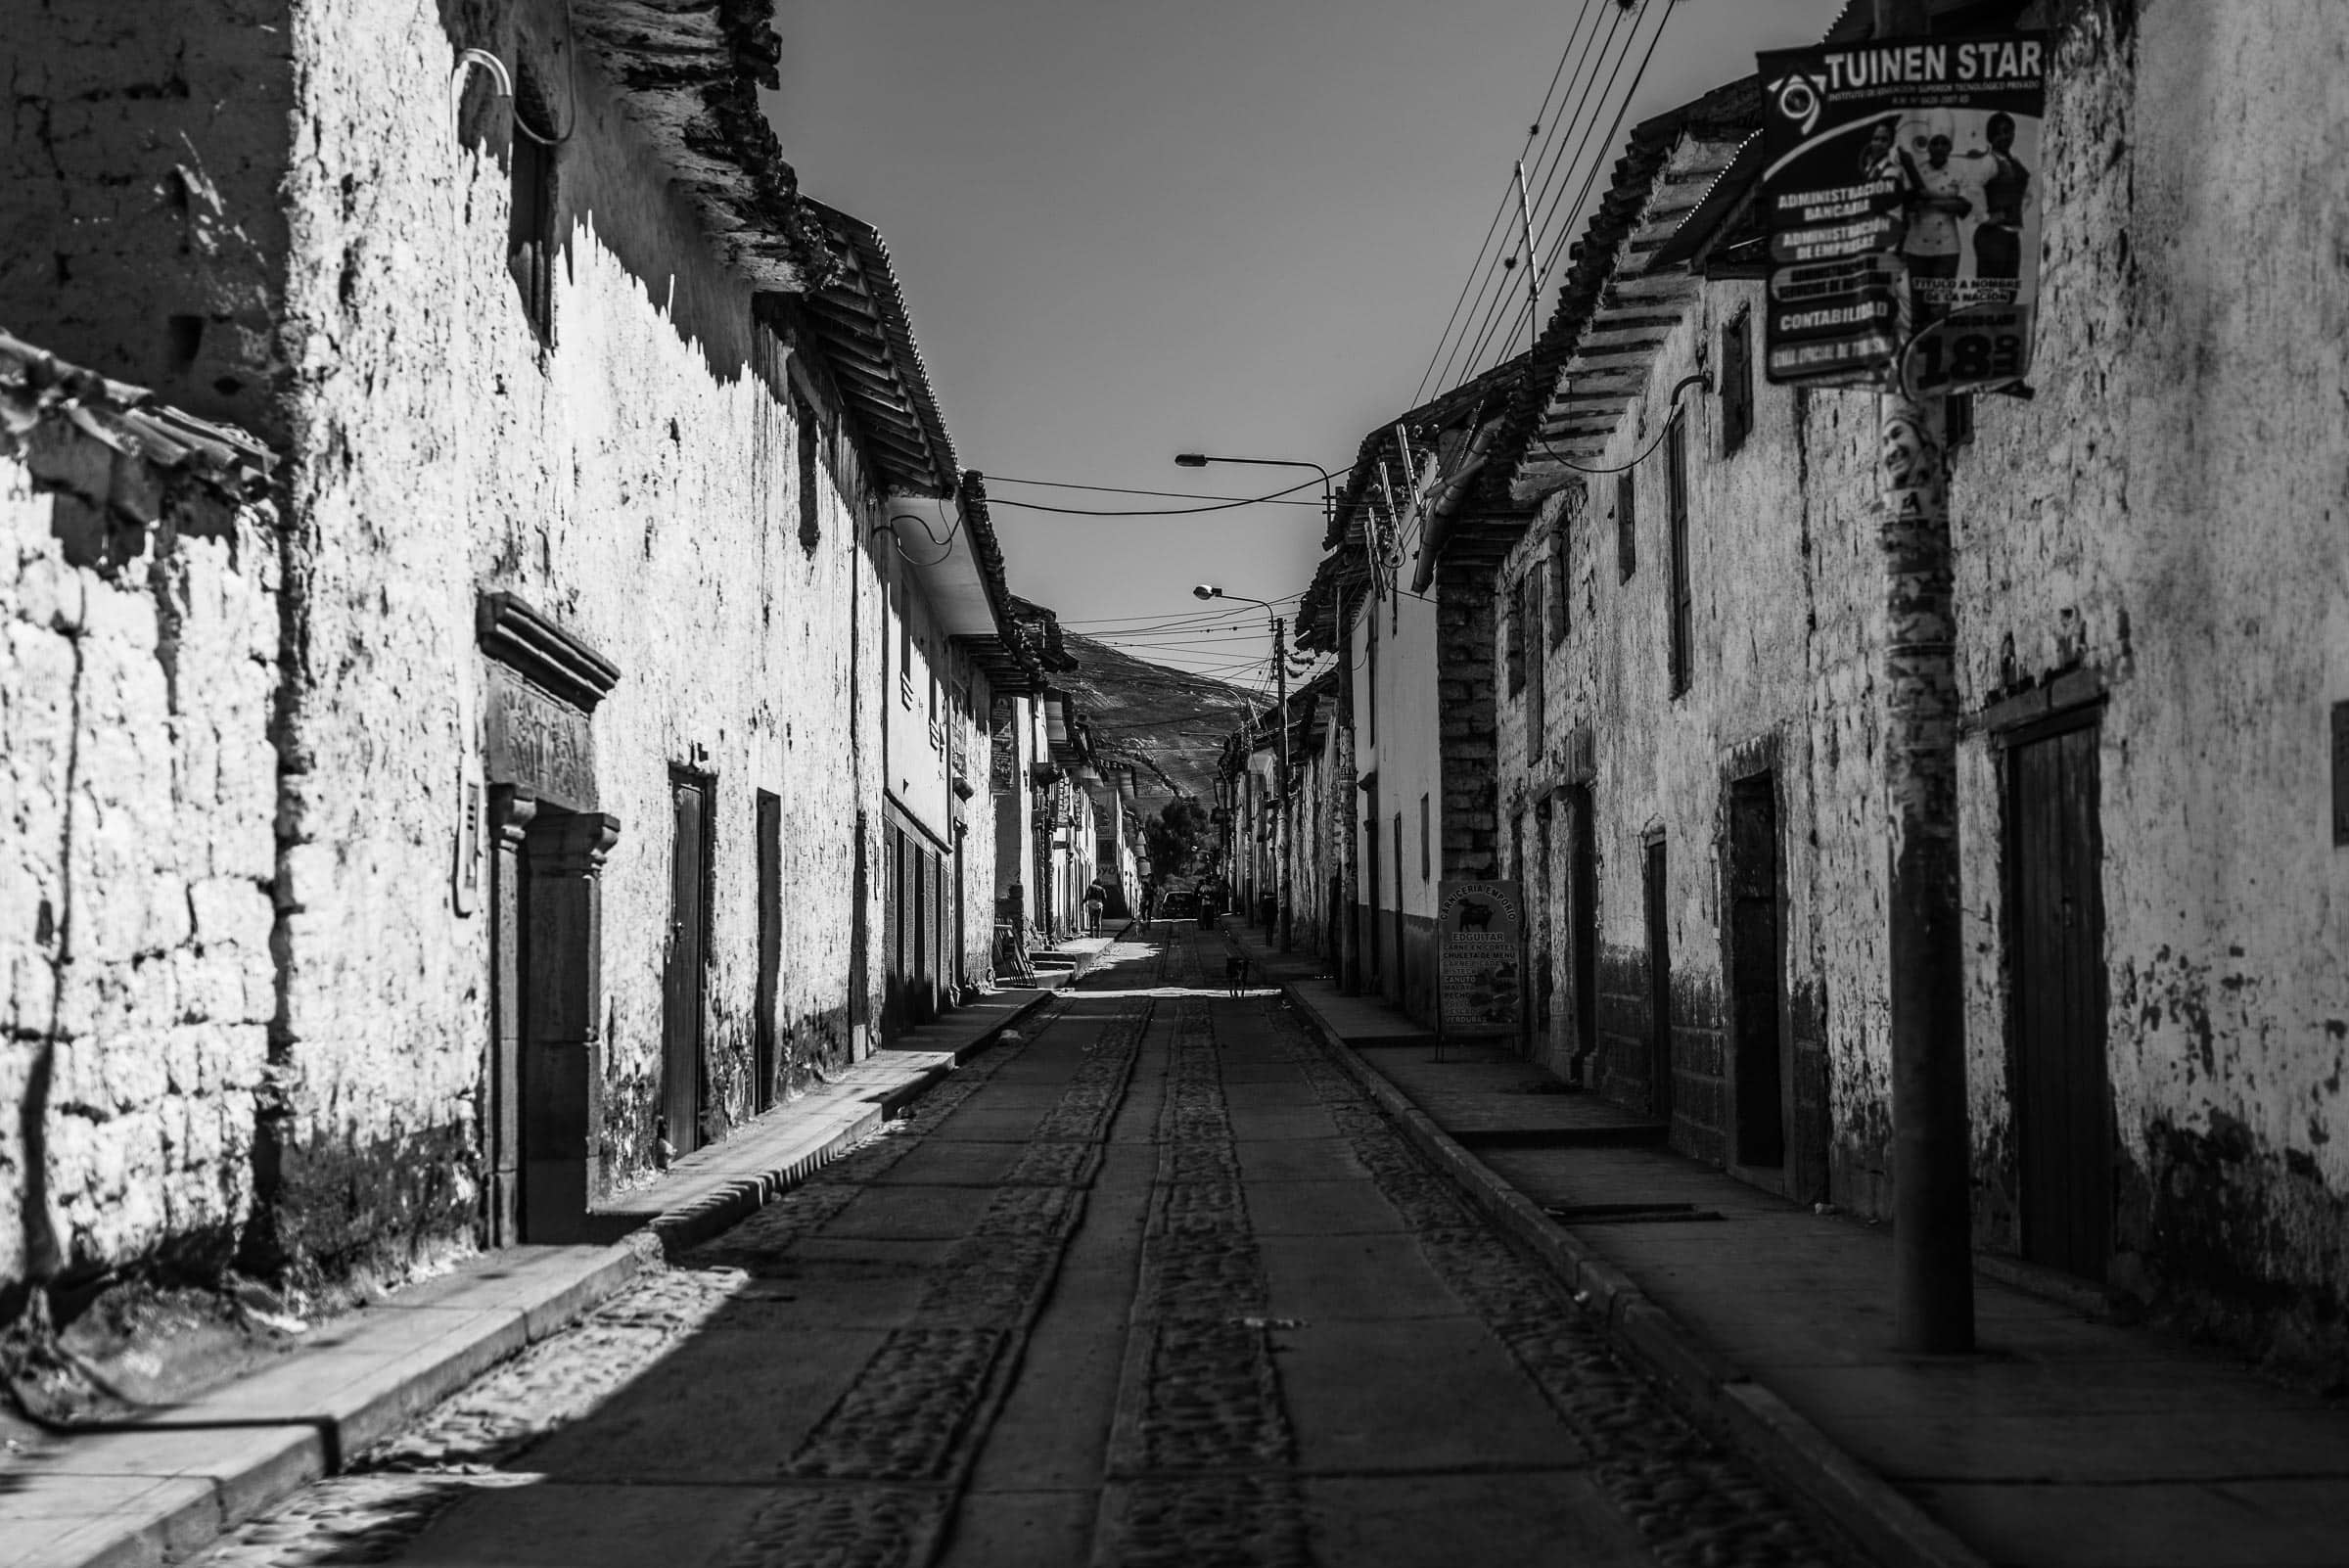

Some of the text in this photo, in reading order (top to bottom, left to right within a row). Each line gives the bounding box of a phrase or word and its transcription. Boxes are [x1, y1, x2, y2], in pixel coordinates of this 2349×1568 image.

[1824, 40, 2042, 89] TUINEN STAR
[1959, 279, 1968, 289] A
[1440, 884, 1516, 920] CARNICERIA EMPORIO
[1452, 933, 1504, 942] EDGUITAR
